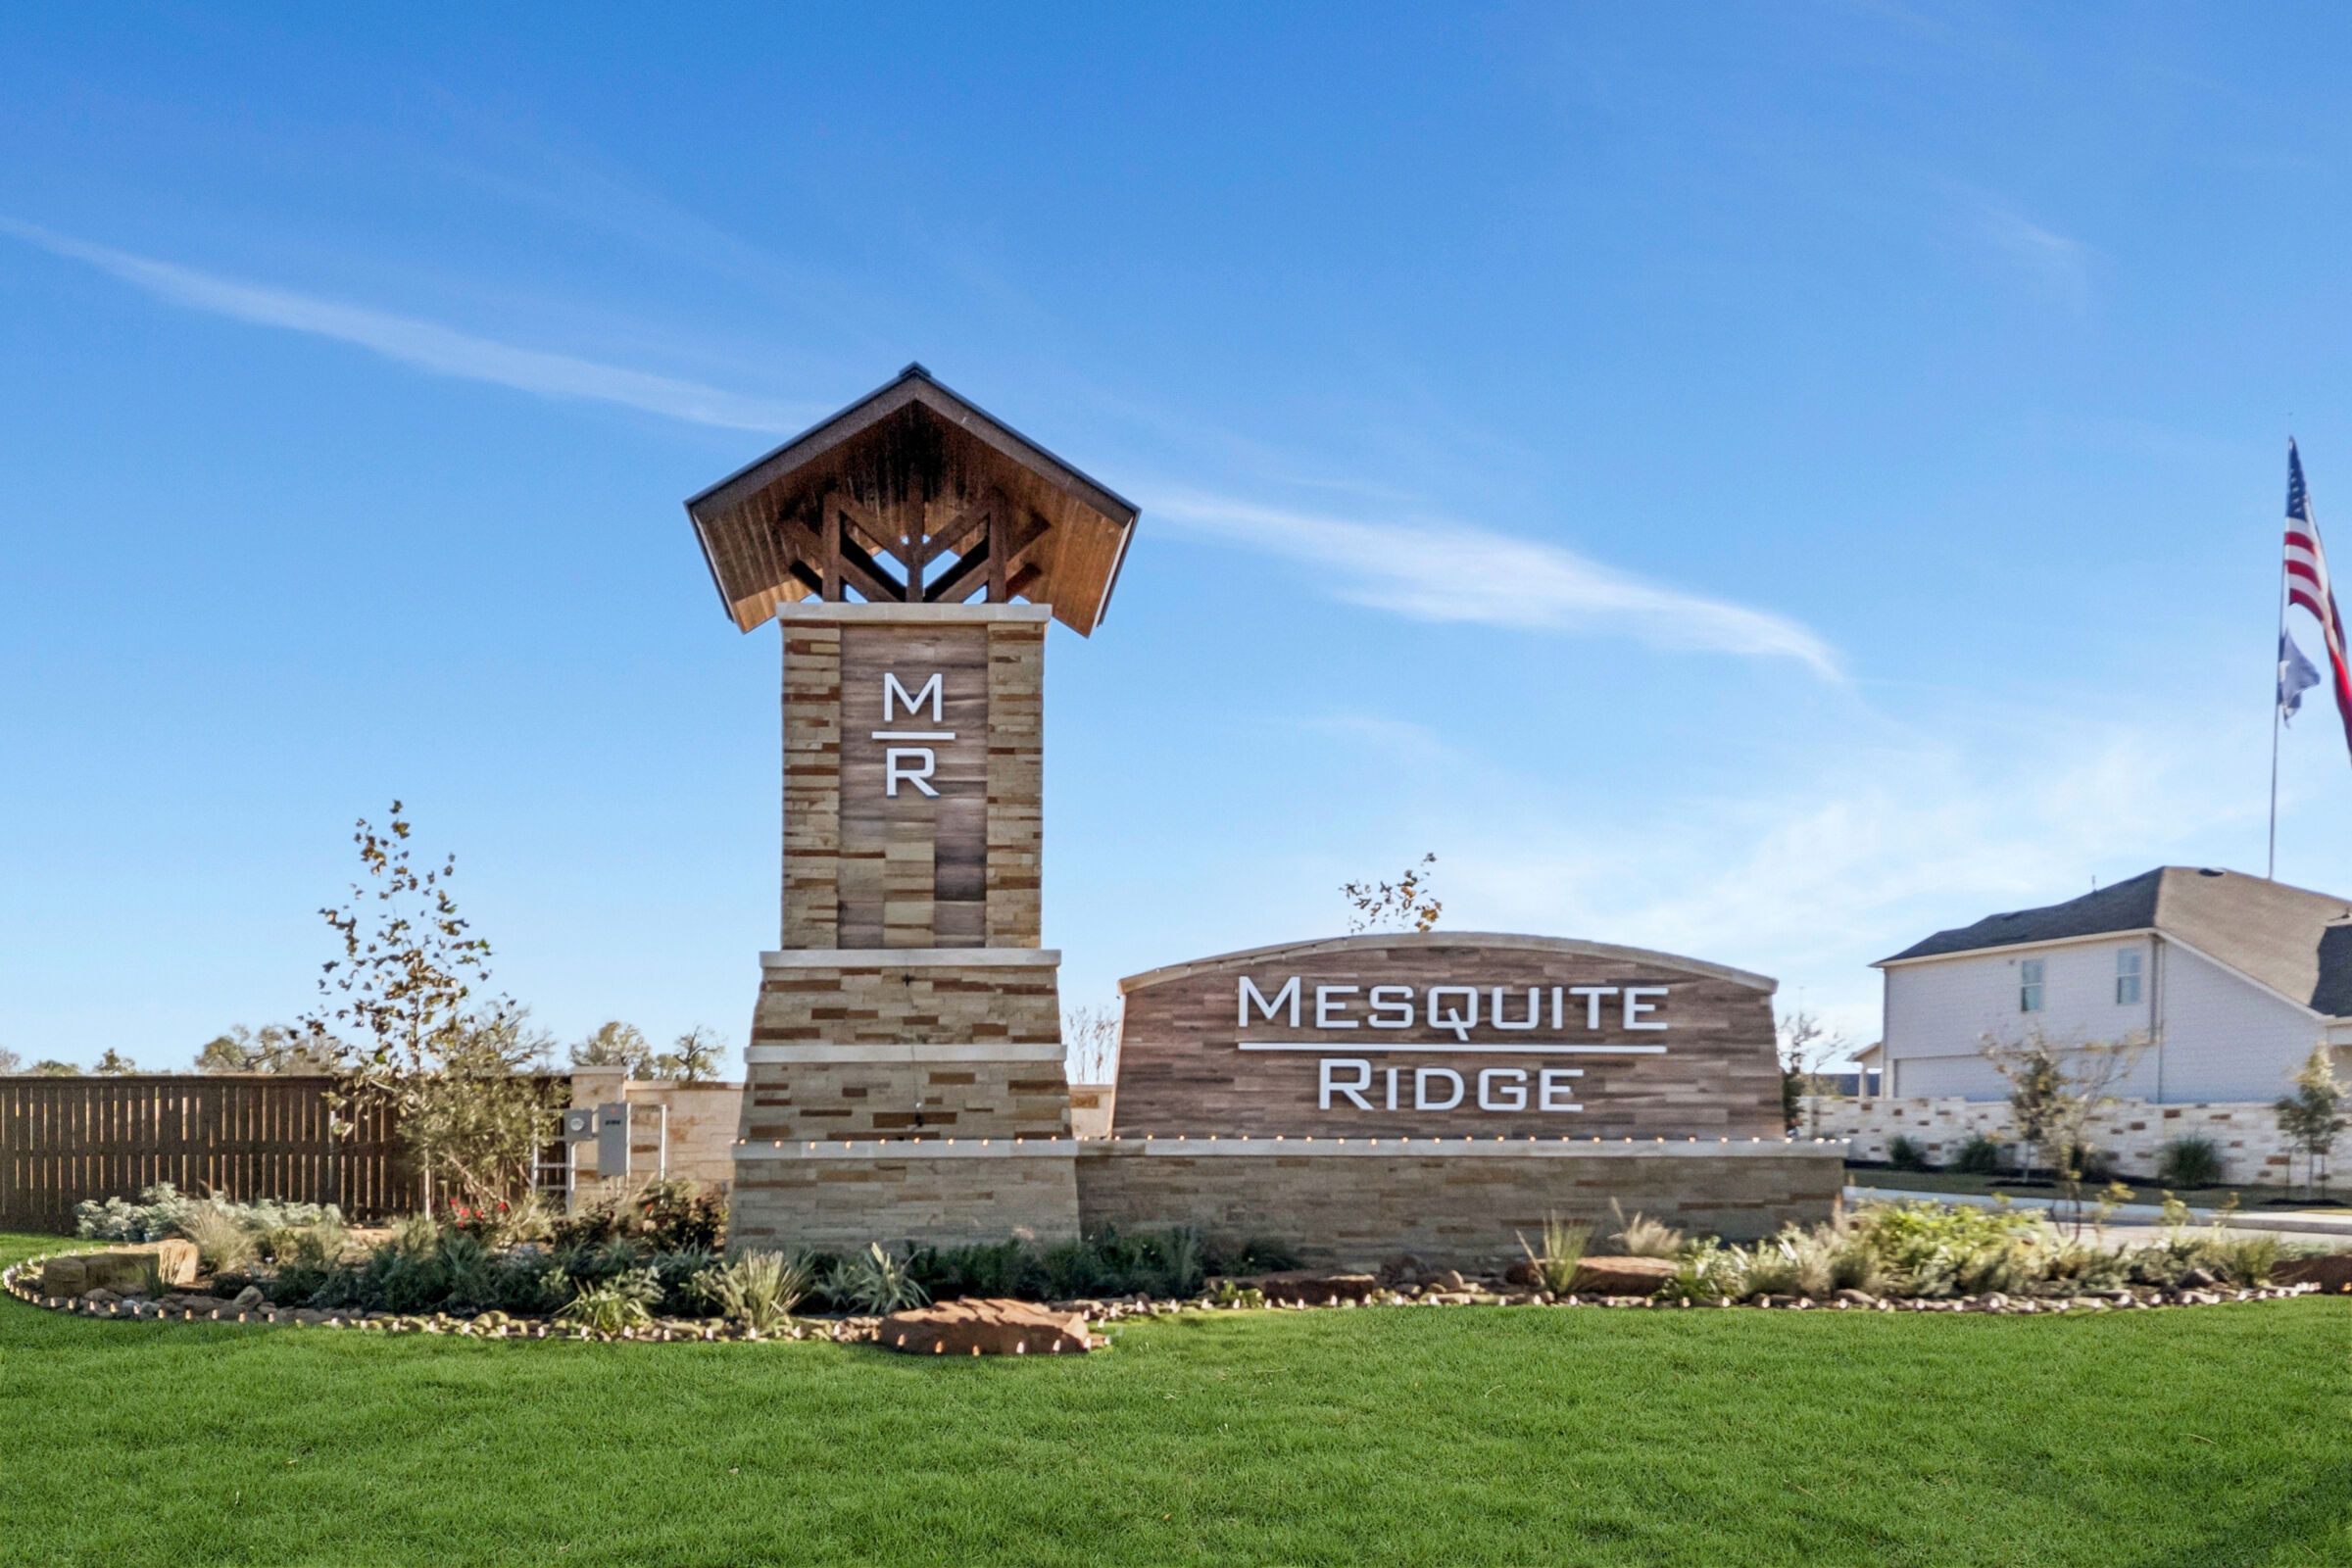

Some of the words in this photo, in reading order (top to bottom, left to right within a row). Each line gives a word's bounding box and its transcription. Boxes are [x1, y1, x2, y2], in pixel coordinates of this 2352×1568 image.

[884, 672, 942, 722] M
[886, 748, 940, 797] R
[1238, 976, 1668, 1041] MESQUITE
[1319, 1058, 1584, 1111] RIDGE
